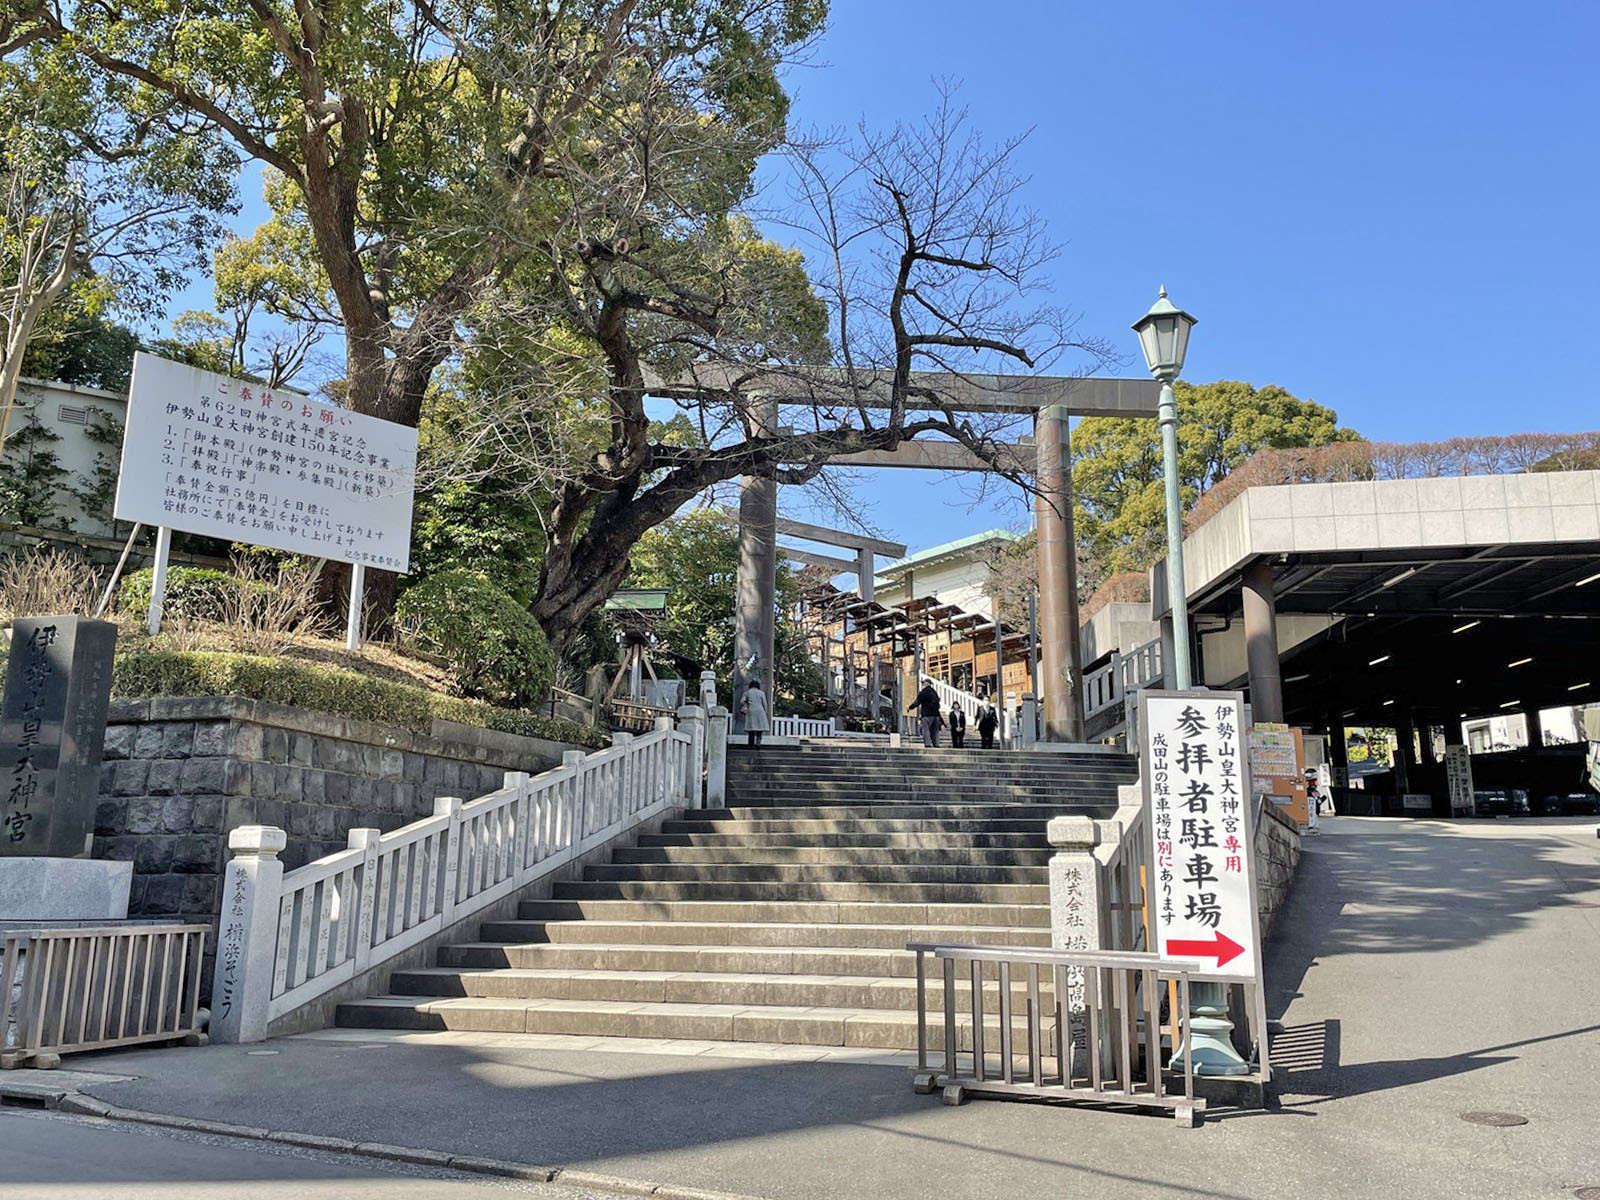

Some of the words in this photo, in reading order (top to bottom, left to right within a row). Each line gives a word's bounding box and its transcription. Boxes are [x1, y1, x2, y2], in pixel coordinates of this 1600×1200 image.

[166, 402, 391, 470] 伊勢山皇大神宮創建150年記念事業
[200, 395, 368, 449] 第62回神宮式年遷宮記念
[218, 382, 353, 426] ご奉賛のお願い
[163, 499, 356, 547] 皆様のご奉賛をお願い申し上げます
[5, 624, 60, 843] 伊勢山皇大神宮
[1214, 705, 1243, 873] 伊勢山皇大神宮専用
[1152, 732, 1176, 927] 成田山の駐車場は別にあります
[1174, 705, 1223, 929] 参拝者駐車場
